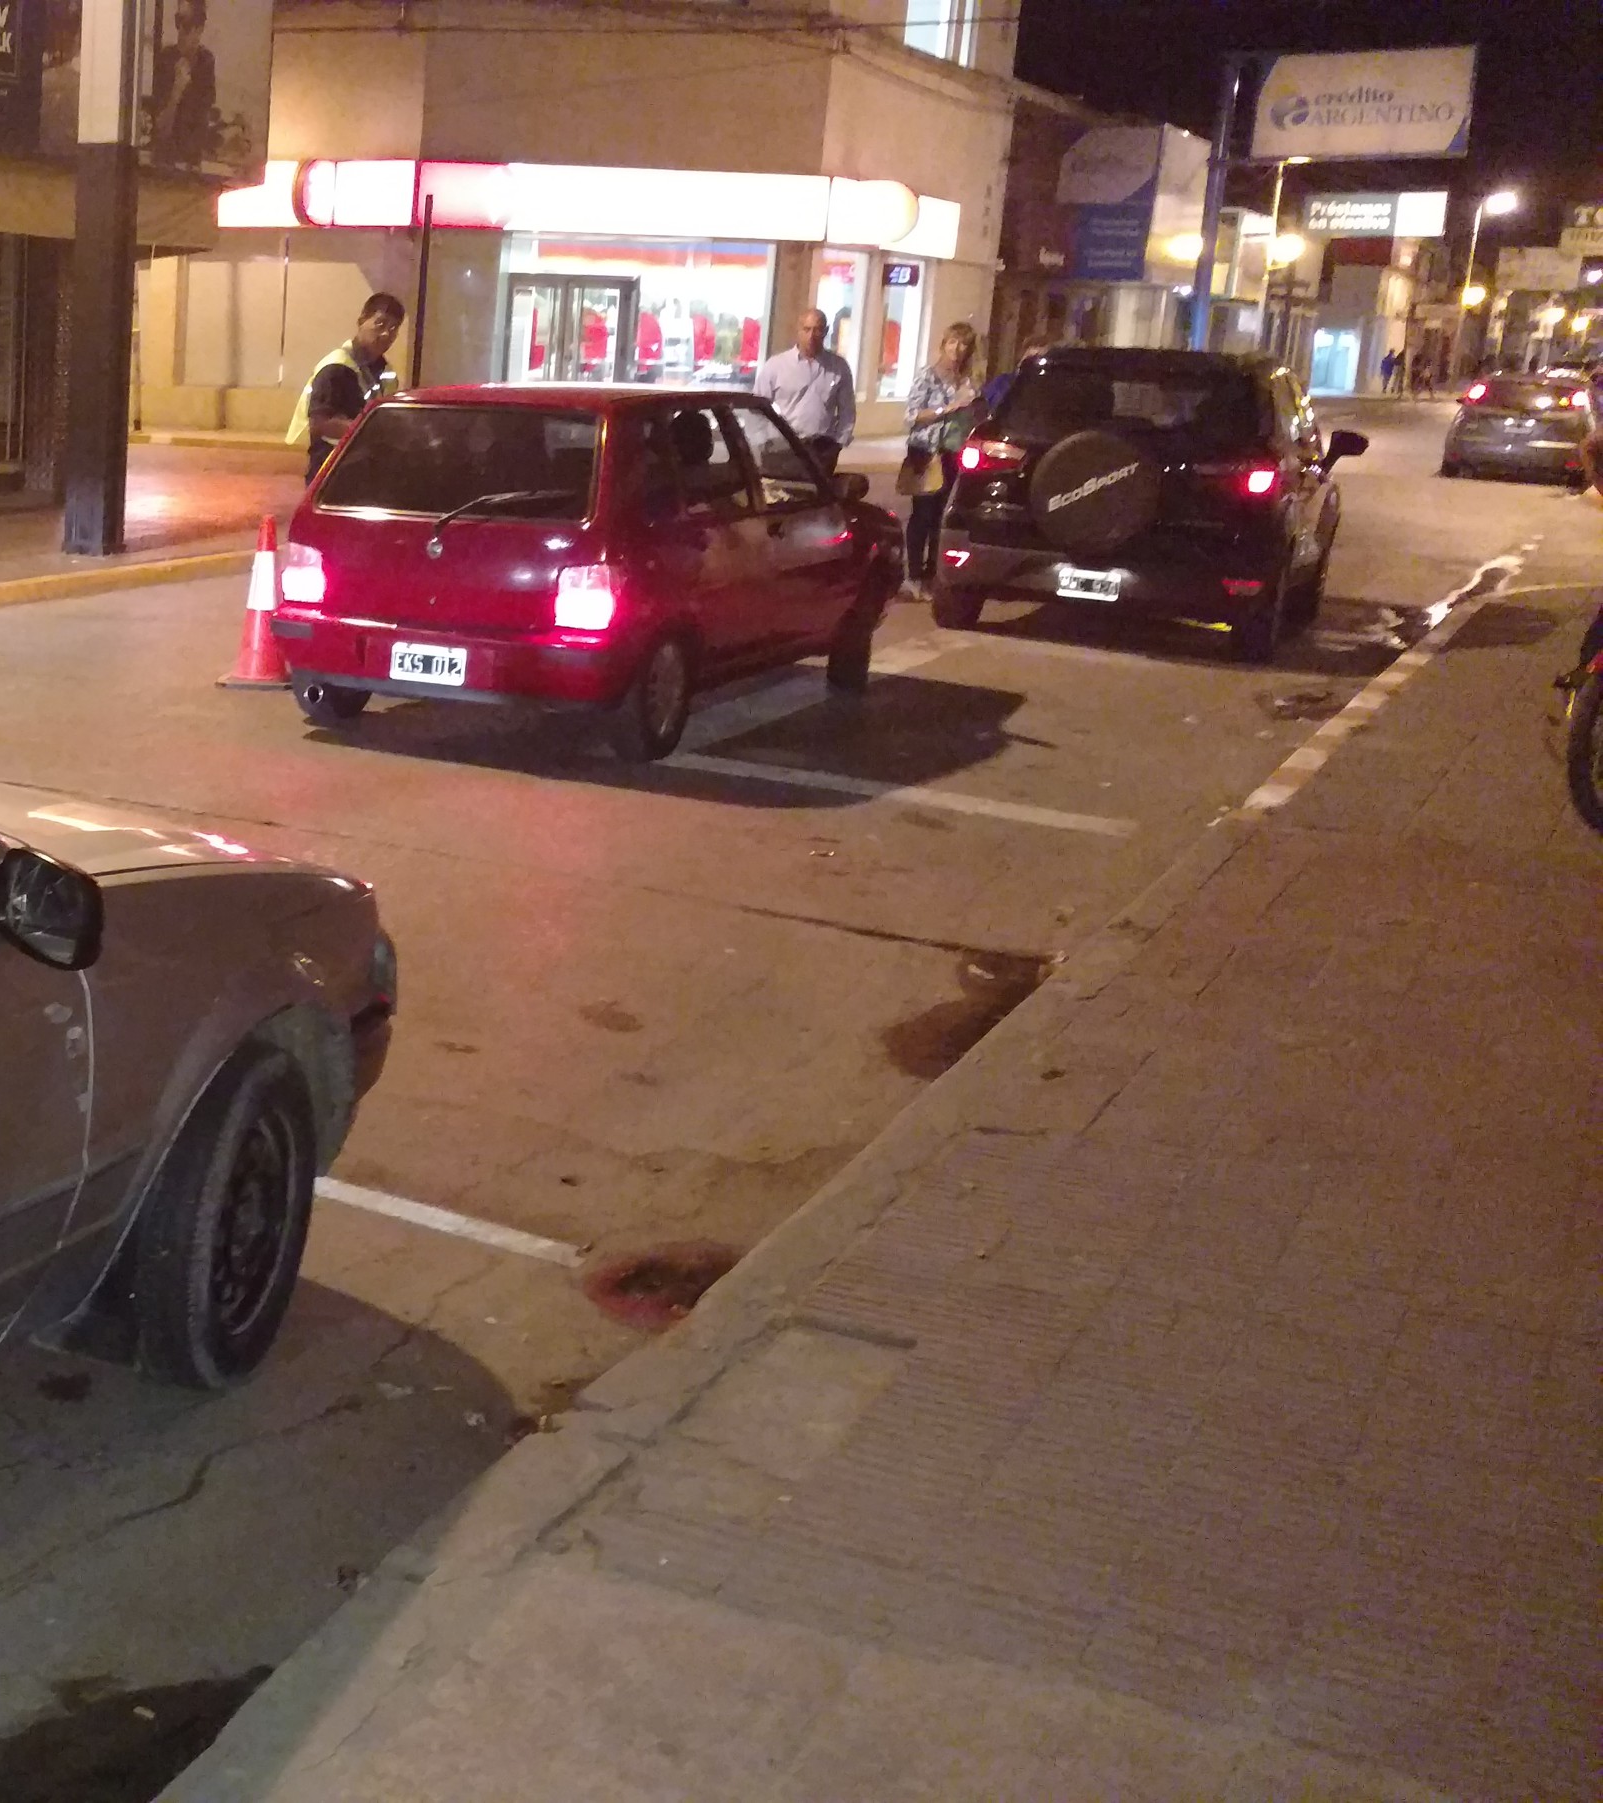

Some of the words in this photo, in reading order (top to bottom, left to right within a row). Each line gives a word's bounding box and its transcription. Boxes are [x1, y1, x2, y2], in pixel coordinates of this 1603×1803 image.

[1310, 101, 1454, 128] ARGENTINO
[395, 652, 424, 674] EKS
[431, 656, 463, 678] 012
